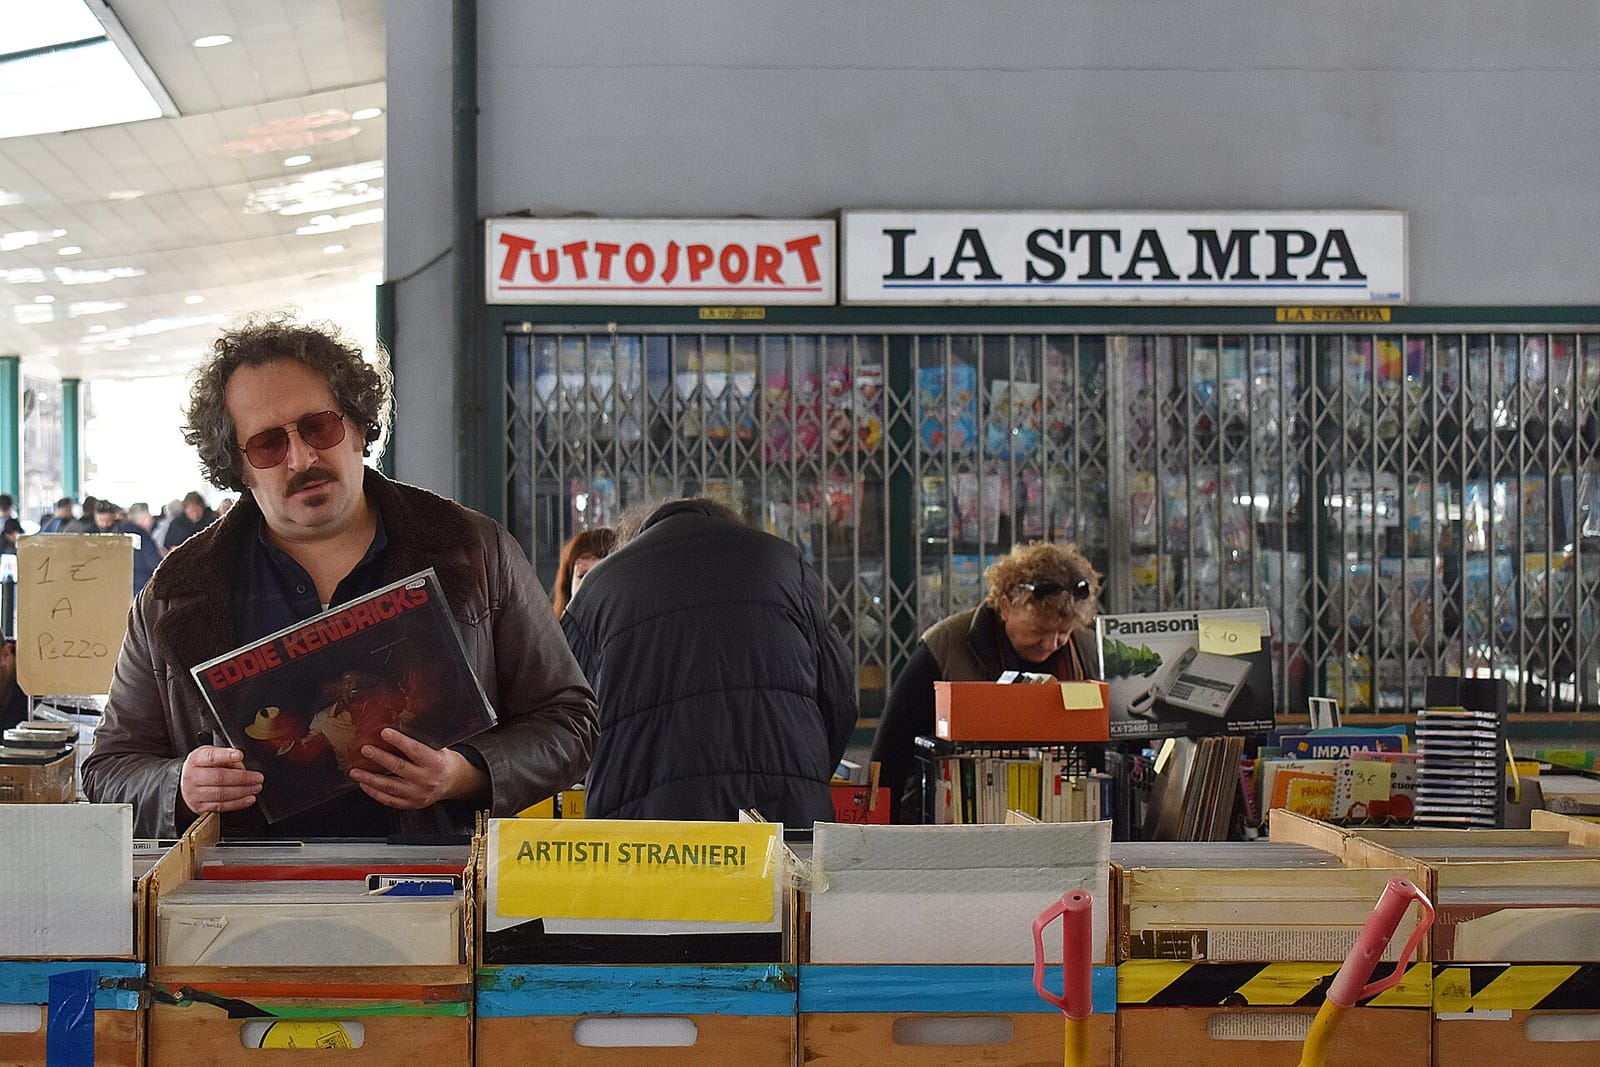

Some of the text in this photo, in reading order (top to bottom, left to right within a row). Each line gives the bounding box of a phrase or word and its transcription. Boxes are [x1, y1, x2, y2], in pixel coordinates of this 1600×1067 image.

[500, 233, 821, 285] TUTTOSPORT
[882, 228, 1367, 282] LA STAMPA
[1284, 308, 1384, 321] LA STAMPA
[37, 556, 54, 585] 1
[51, 597, 73, 619] A
[206, 585, 430, 692] EDDIE KENDRICKS
[1105, 614, 1199, 635] Panasoni
[1220, 633, 1238, 643] 10
[37, 632, 109, 661] PEZZO
[516, 840, 747, 867] ARTISTI STRANIERI
